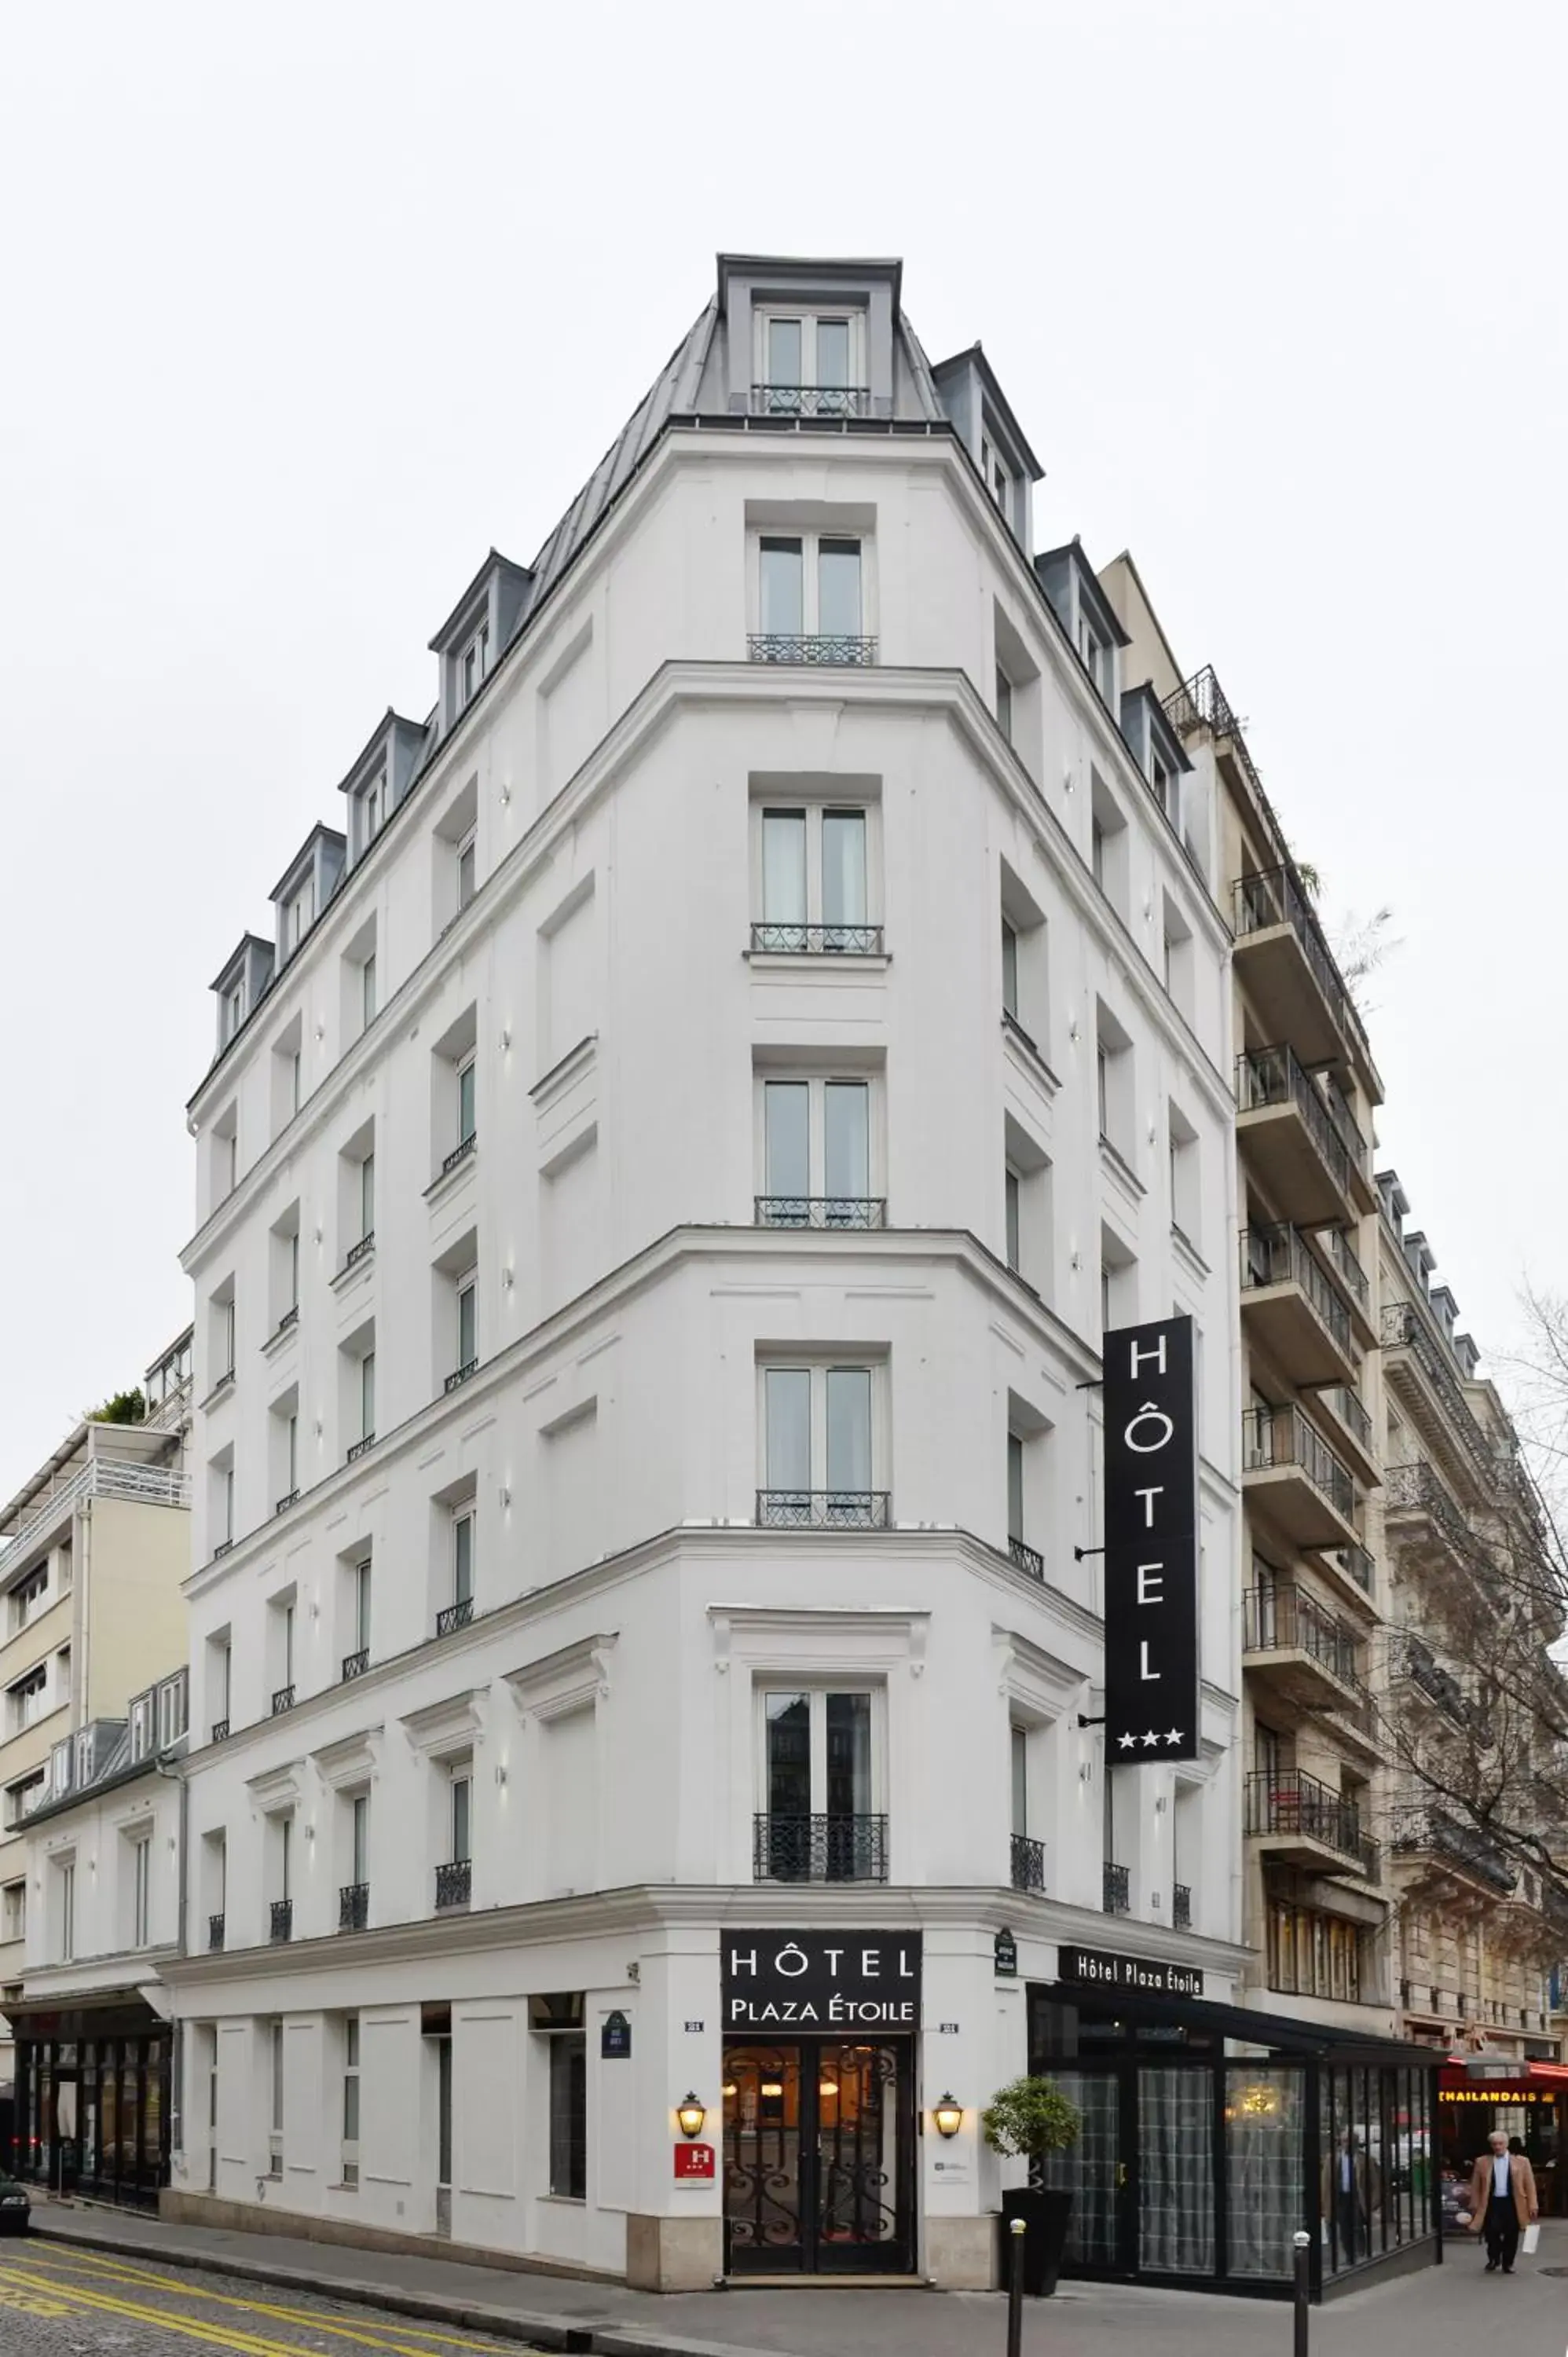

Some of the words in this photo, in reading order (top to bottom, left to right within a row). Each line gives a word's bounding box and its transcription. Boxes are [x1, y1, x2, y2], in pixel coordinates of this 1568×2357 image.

[1124, 1335, 1174, 1681] HÔTEL
[731, 1941, 914, 1977] HÔTEL
[1079, 1956, 1118, 1982] Hôtel
[1126, 1963, 1163, 1988] Plaza
[1167, 1966, 1201, 1993] Étoile
[731, 1999, 819, 2021] PLAZA
[829, 1993, 914, 2021] ÉTOILE
[692, 2150, 709, 2163] H
